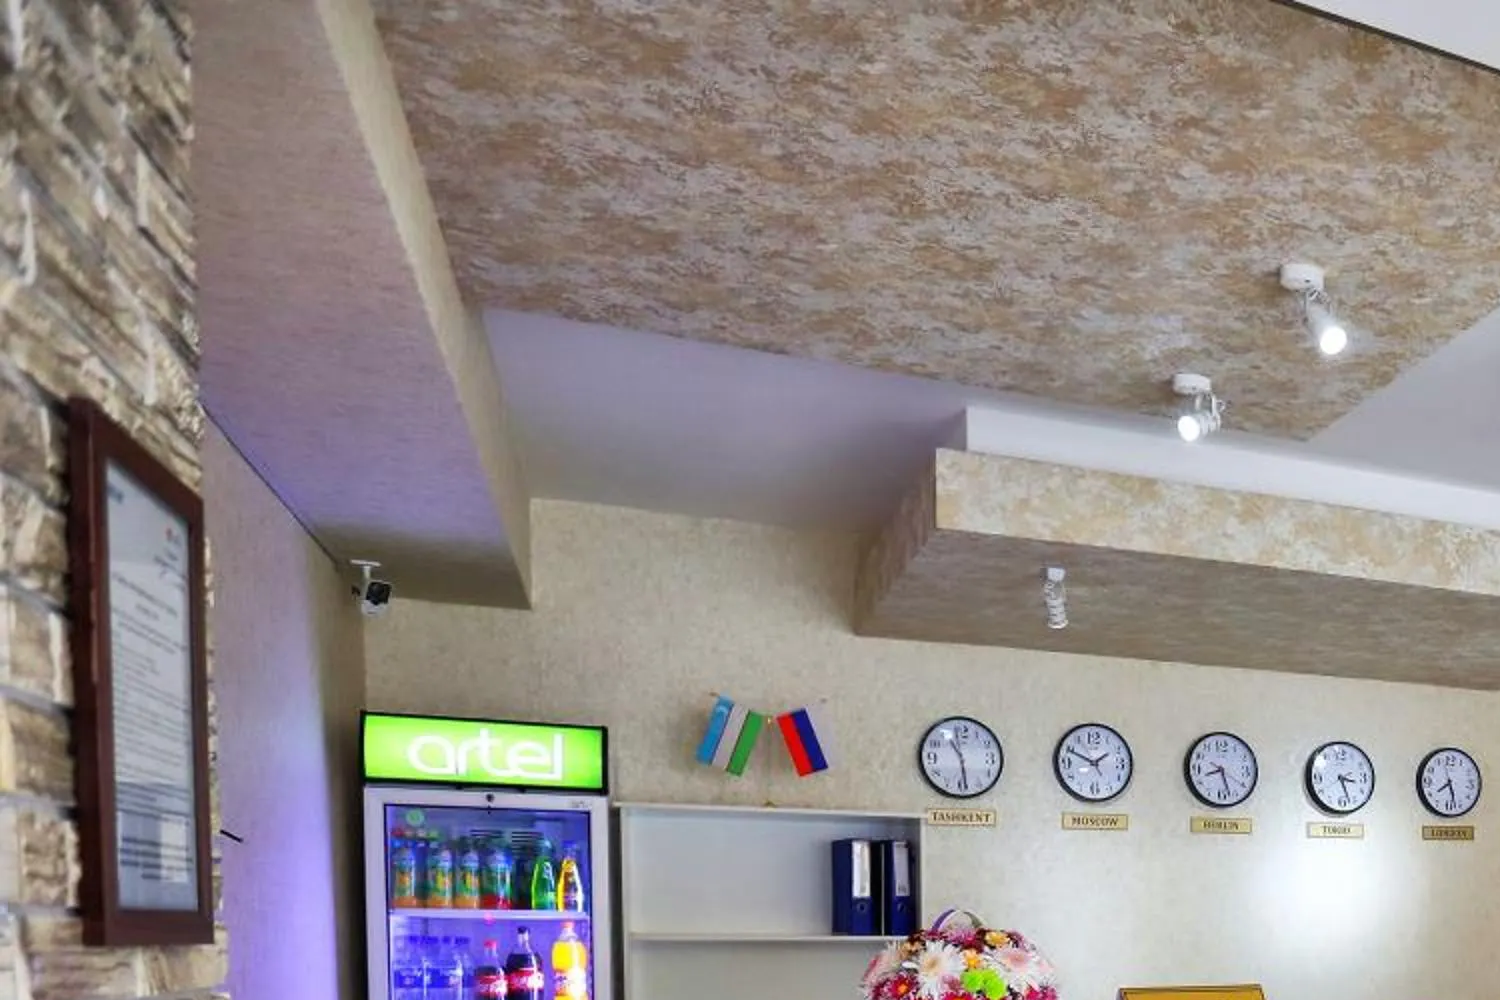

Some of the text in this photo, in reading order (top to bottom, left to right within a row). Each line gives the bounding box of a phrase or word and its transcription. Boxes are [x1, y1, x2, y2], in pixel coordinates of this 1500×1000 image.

[408, 727, 564, 780] artel
[932, 811, 991, 823] TASHKENT
[1071, 815, 1119, 827] MOSCOW
